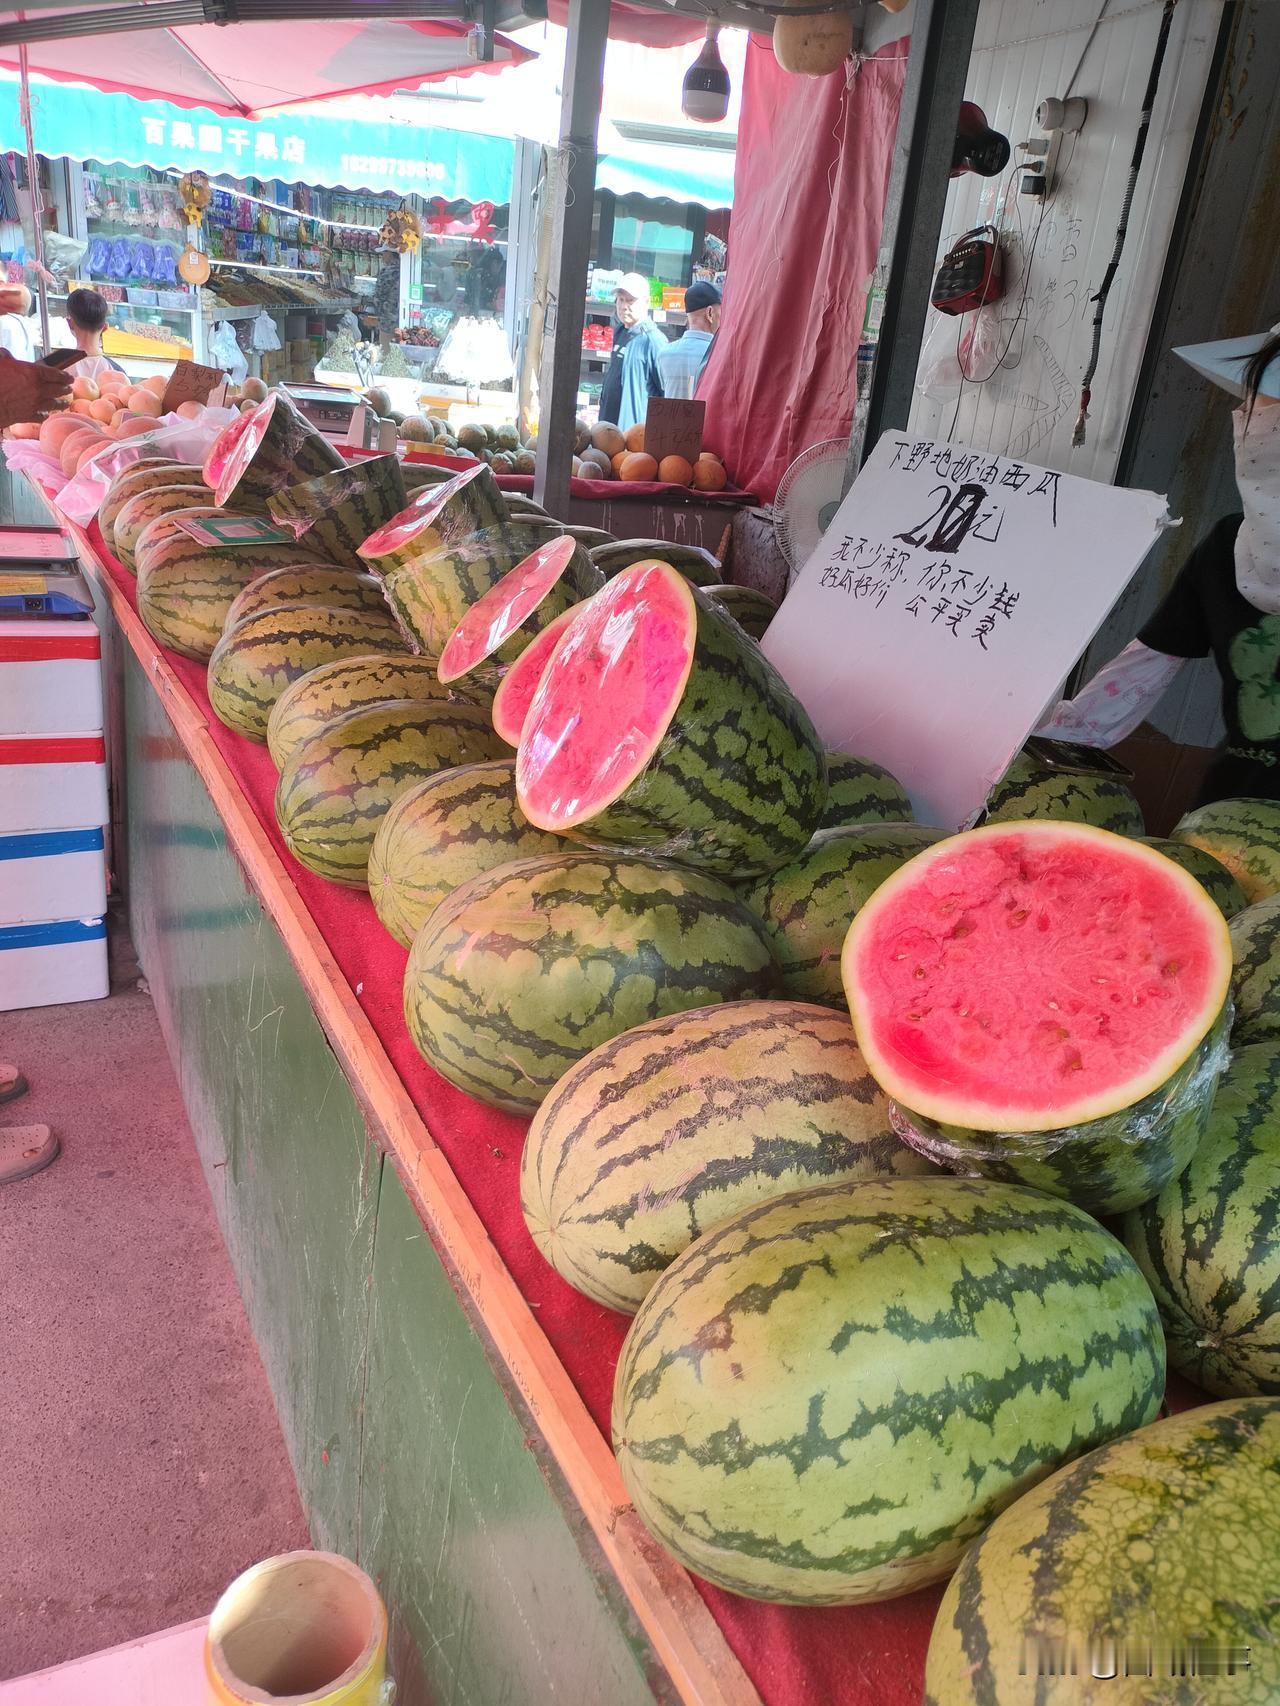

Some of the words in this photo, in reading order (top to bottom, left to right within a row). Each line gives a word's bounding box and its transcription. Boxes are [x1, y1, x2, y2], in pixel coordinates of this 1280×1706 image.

[889, 442, 1062, 527] 下野地奶油西瓜
